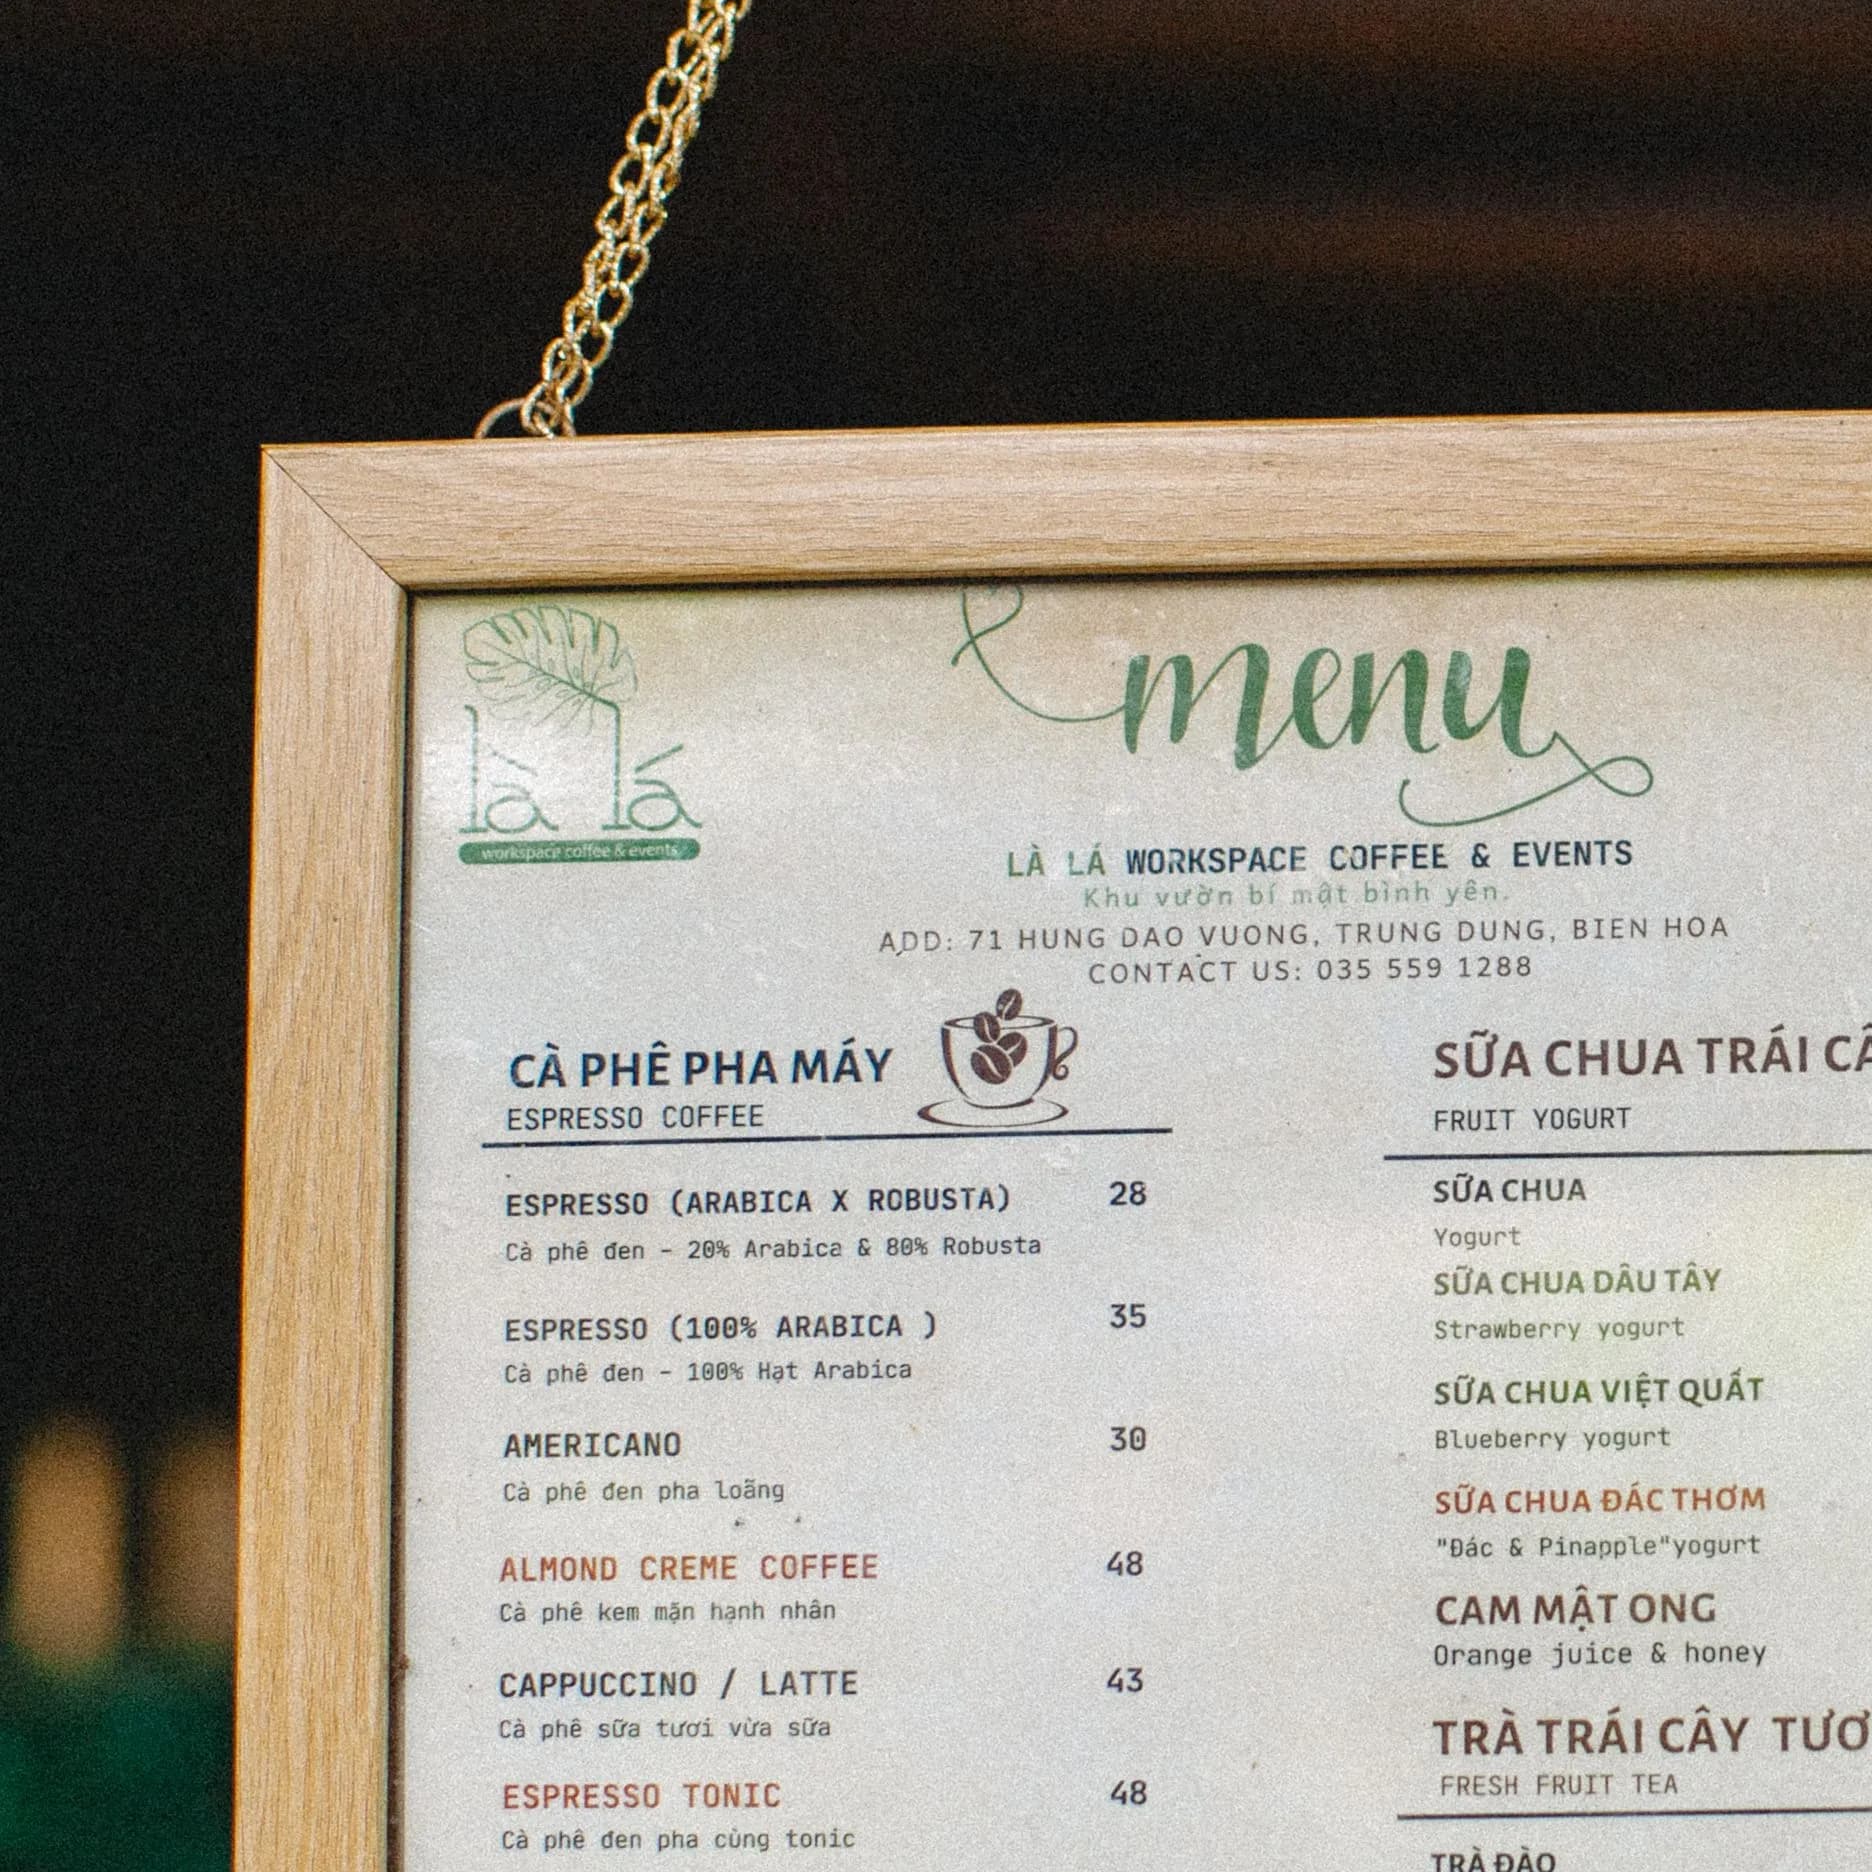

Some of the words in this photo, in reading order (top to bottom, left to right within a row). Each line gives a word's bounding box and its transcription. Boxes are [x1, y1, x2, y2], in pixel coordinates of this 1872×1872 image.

[459, 704, 560, 834] là
[601, 701, 703, 832] lá
[1007, 844, 1045, 878] LÀ
[1067, 849, 1106, 876] LÁ
[1125, 845, 1306, 876] WORKSPACE
[1329, 842, 1449, 872] COFFEE
[1470, 842, 1490, 870] &
[1512, 838, 1634, 869] EVENTS
[878, 929, 952, 955] ADD:
[968, 928, 1003, 952] 71
[1017, 926, 1106, 951] HUNG
[1120, 925, 1185, 949] DAO
[1198, 922, 1320, 948] VUONG,
[1335, 920, 1442, 945] TRUNG
[1456, 918, 1556, 943] DUNG,
[1572, 917, 1648, 941] BIEN
[1663, 915, 1729, 940] HOA
[1087, 960, 1237, 985] CONTACT
[1251, 959, 1301, 983] US:
[1316, 957, 1372, 982] 035
[1387, 956, 1443, 981] 559
[1458, 955, 1532, 979] 1288
[508, 1041, 567, 1089] CÀ
[580, 1039, 672, 1088] PHÊ
[683, 1049, 778, 1086] PHA
[790, 1036, 893, 1084] MÁY
[1433, 1028, 1532, 1080] SỮA
[1544, 1038, 1684, 1078] CHUA
[1696, 1023, 1808, 1075] TRÁI
[506, 1105, 644, 1132] ESPRESSO
[661, 1103, 764, 1130] COFFEE
[1433, 1107, 1516, 1133] FRUIT
[1532, 1105, 1632, 1131] YOGURT
[505, 1191, 650, 1218] ESPRESSO
[670, 1188, 813, 1218] (ARABICA
[831, 1189, 849, 1213] X
[867, 1183, 1010, 1214] ROBUSTA)
[1109, 1179, 1148, 1207] 28
[1433, 1227, 1521, 1252] Yogurt
[1434, 1318, 1581, 1343] Strawberry
[1597, 1316, 1684, 1342] yogurt
[502, 1430, 682, 1459] AMERICANO
[1110, 1425, 1148, 1453] 30
[1434, 1428, 1568, 1452] Blueberry
[1582, 1426, 1671, 1452] yogurt
[502, 1481, 532, 1503] Cà
[544, 1479, 588, 1506] phê
[601, 1480, 644, 1502] đen
[657, 1480, 701, 1504] pha
[714, 1478, 786, 1504] loãng
[499, 1555, 619, 1583] ALMOND
[639, 1554, 738, 1582] CREME
[760, 1553, 878, 1581] COFFEE
[1105, 1550, 1144, 1577] 48
[1432, 1643, 1533, 1672] Orange
[1552, 1641, 1633, 1670] juice
[1650, 1640, 1667, 1665] &
[1683, 1640, 1767, 1668] honey
[498, 1670, 698, 1699] CAPPUCCINO
[719, 1667, 737, 1701] /
[760, 1668, 858, 1697] LATTE
[1106, 1666, 1145, 1694] 43
[502, 1782, 661, 1811] ESPRESSO
[682, 1781, 781, 1809] TONIC
[1109, 1779, 1148, 1807] 48
[1440, 1774, 1519, 1798] FRESH
[1535, 1772, 1614, 1797] FRUIT
[1631, 1772, 1679, 1795] TEA
